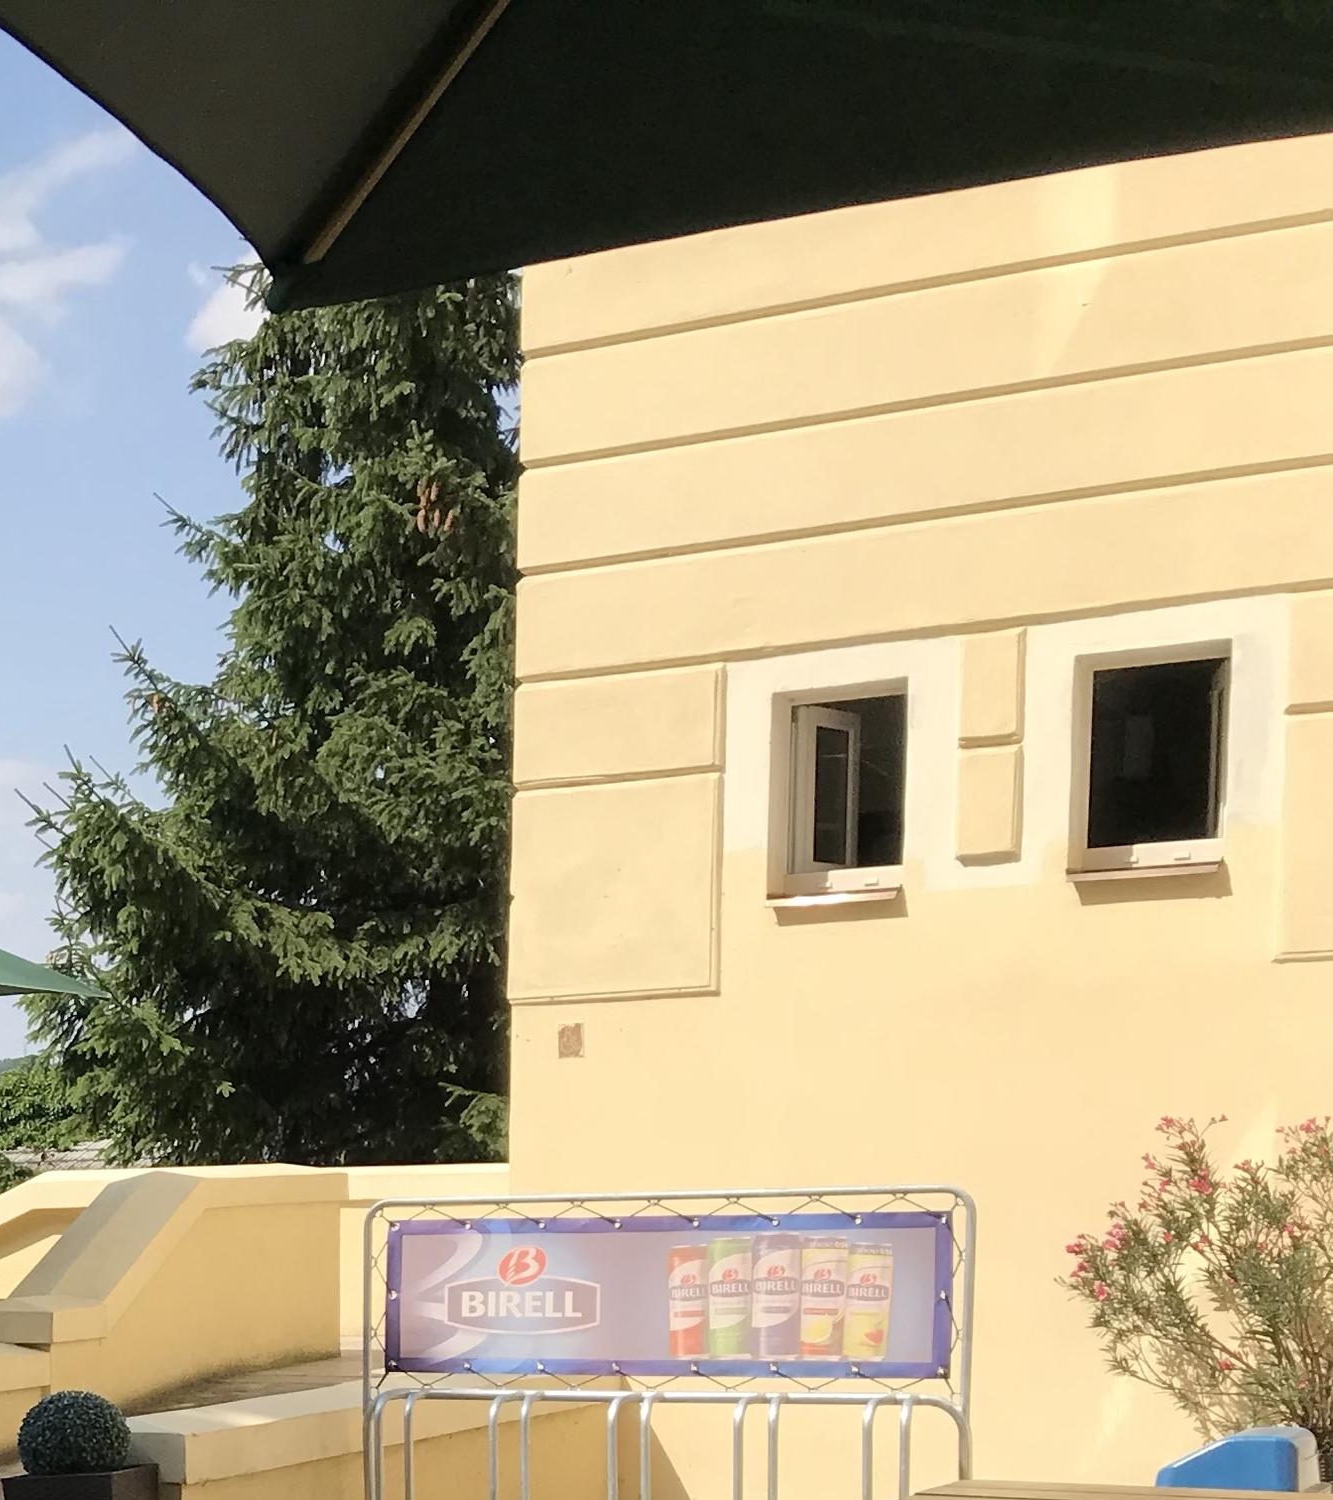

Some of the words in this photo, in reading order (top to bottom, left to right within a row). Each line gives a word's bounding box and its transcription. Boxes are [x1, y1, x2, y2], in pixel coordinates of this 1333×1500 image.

[712, 1282, 748, 1294] BIRELL
[754, 1280, 796, 1292] BIRELL
[801, 1282, 842, 1294] BIRELL
[848, 1286, 886, 1297] BIRELL
[461, 1291, 582, 1318] BIRELL
